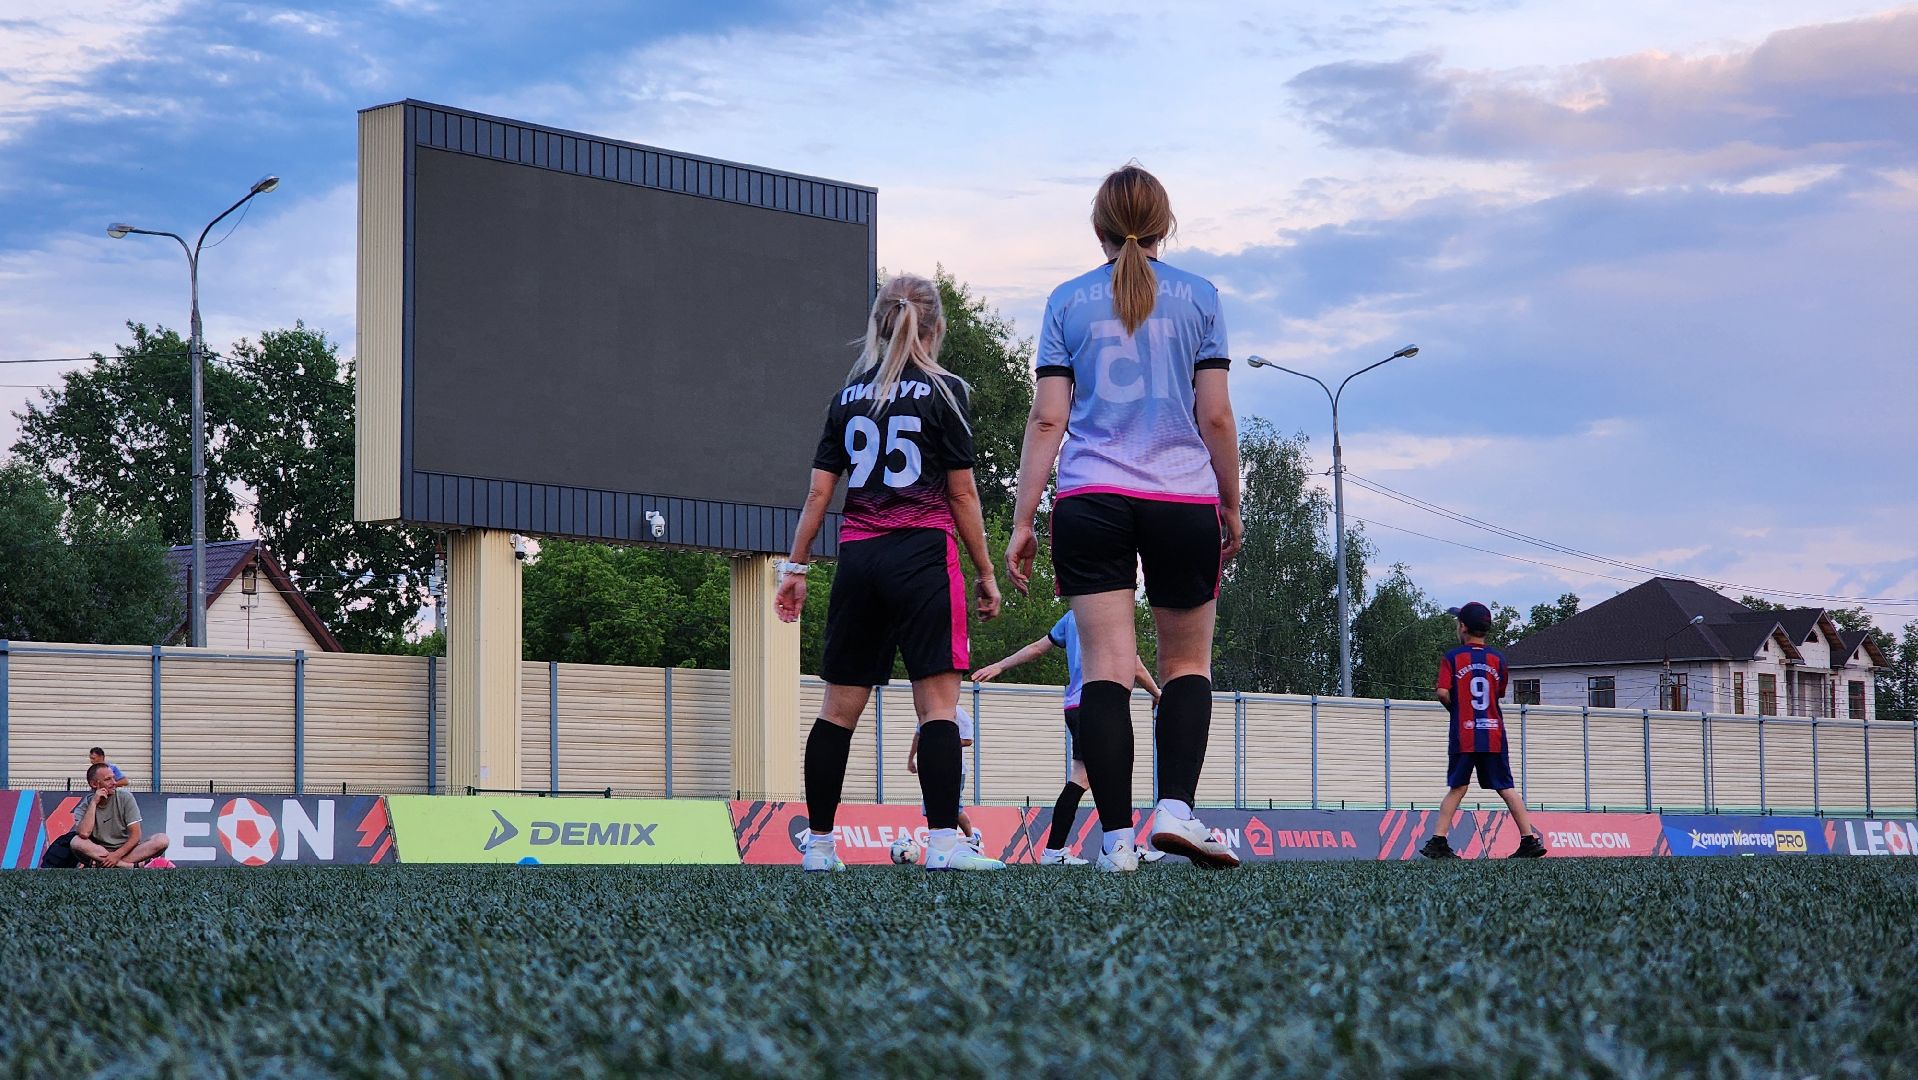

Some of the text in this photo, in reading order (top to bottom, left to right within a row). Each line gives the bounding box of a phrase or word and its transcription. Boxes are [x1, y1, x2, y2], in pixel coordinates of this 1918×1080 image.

[844, 415, 922, 489] 95
[1470, 676, 1490, 711] 9
[528, 821, 659, 847] DEMIX
[1277, 830, 1338, 848] ЛИГА
[1341, 831, 1357, 848] А
[1548, 831, 1631, 849] 2FNL.COM
[1777, 834, 1804, 848] PRO
